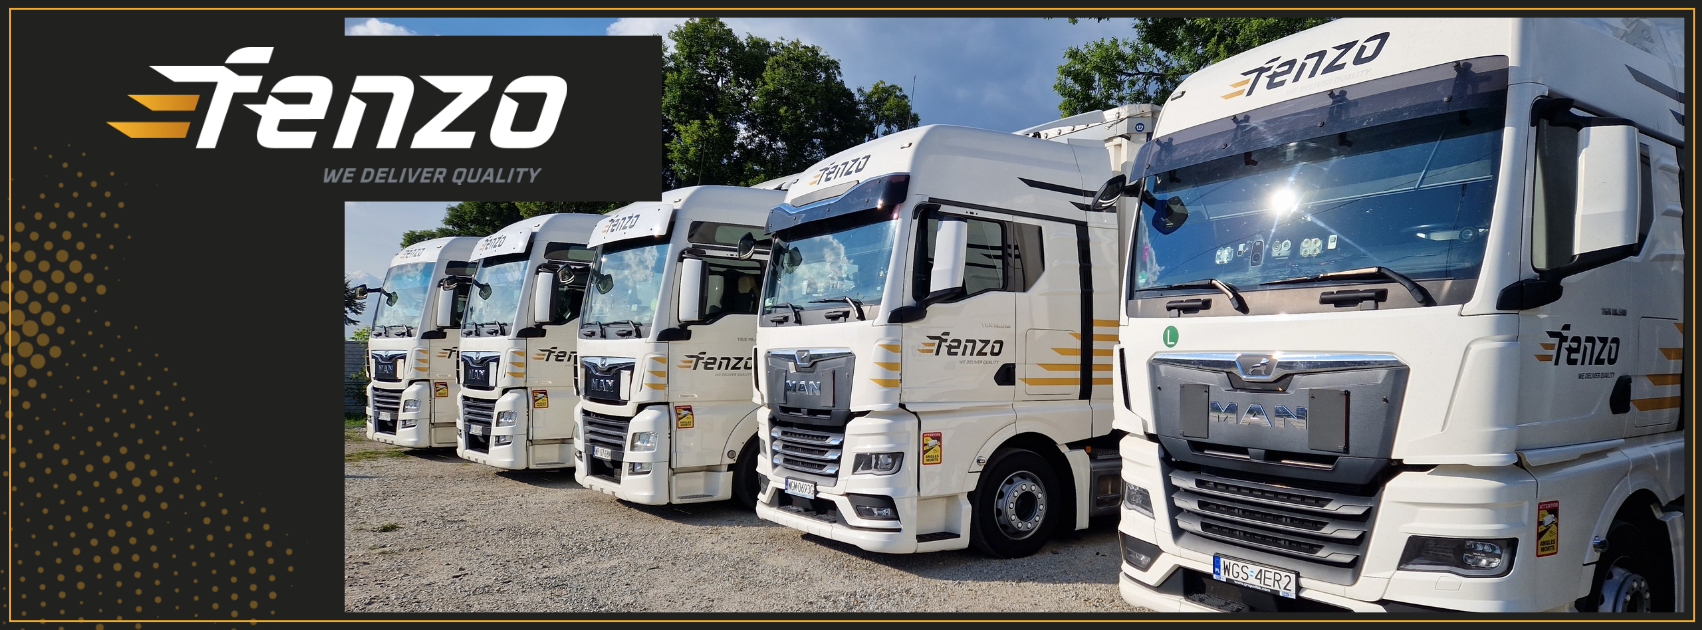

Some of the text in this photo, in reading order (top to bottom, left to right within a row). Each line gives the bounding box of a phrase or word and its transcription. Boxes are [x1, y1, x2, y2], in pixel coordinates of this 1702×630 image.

[1240, 31, 1390, 97] fenzo
[817, 154, 871, 185] fenzo
[926, 331, 1004, 356] fenzo
[1167, 329, 1175, 345] L
[1545, 323, 1620, 366] fenzo
[786, 380, 821, 395] MAN
[1209, 401, 1307, 430] MAN
[1222, 563, 1249, 582] WGS
[1254, 571, 1292, 592] 4ER2
